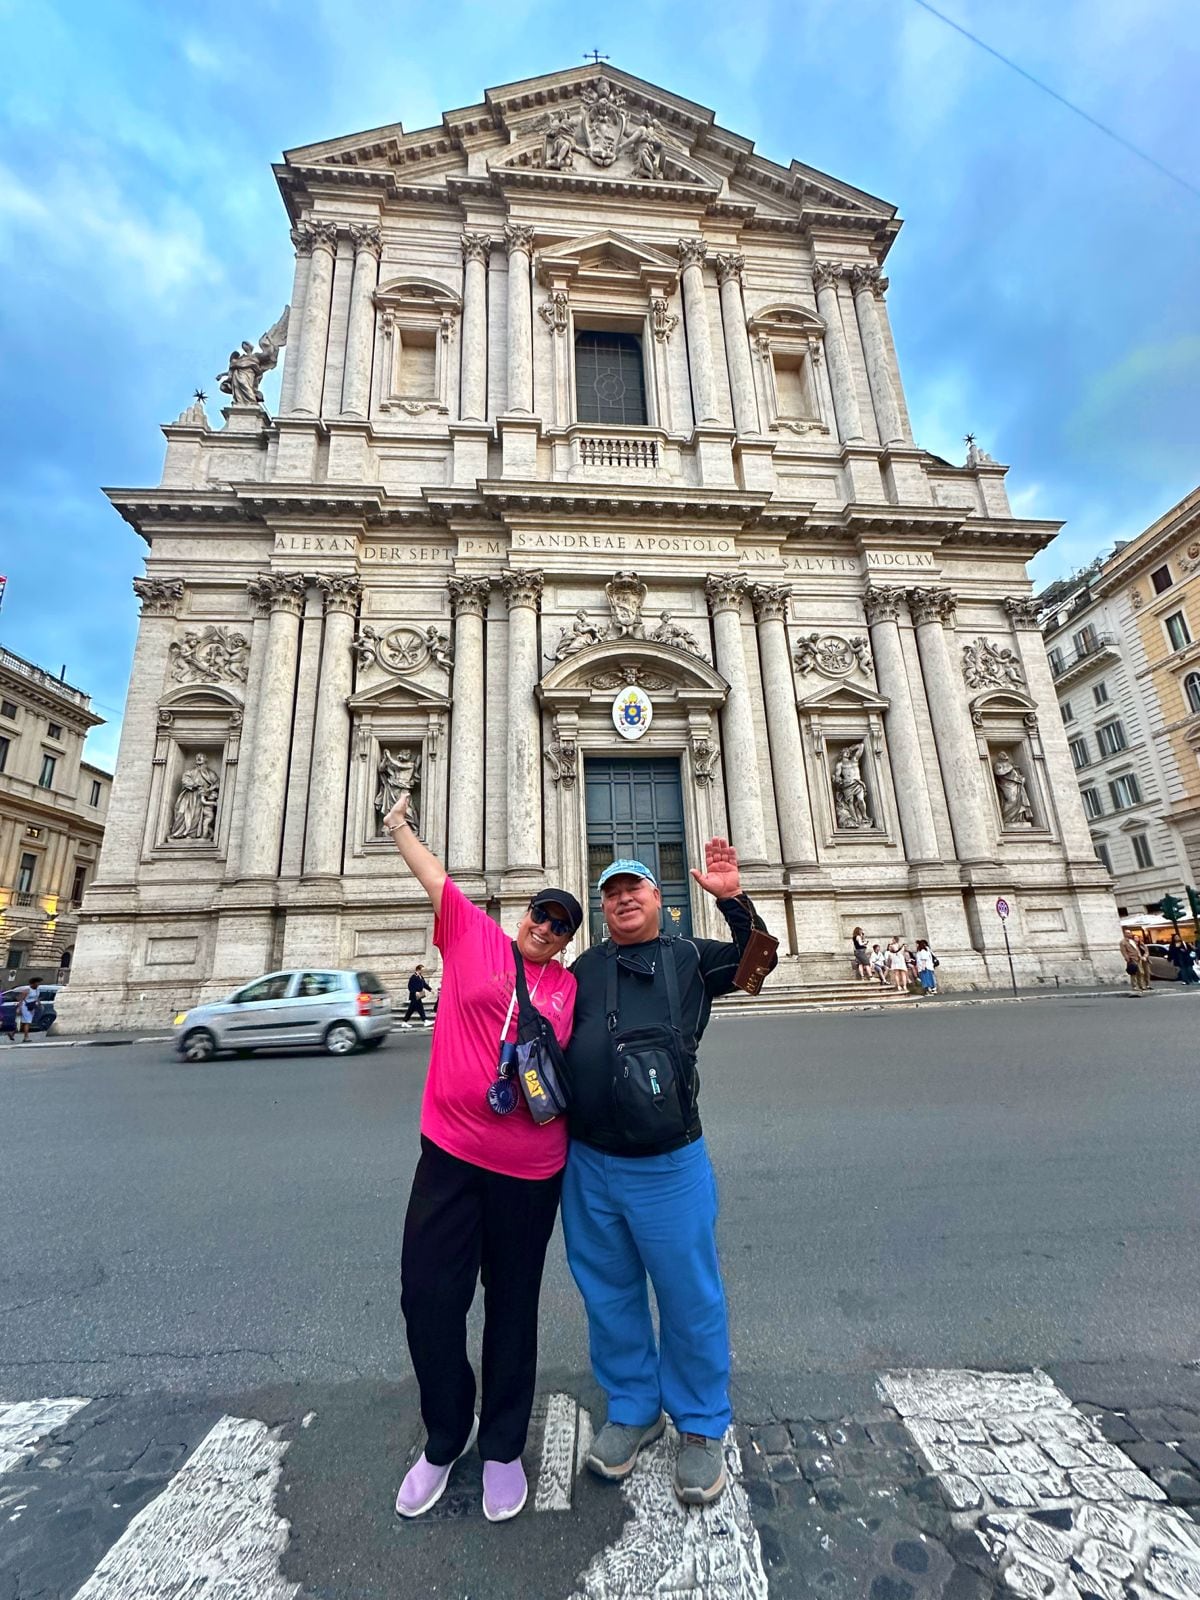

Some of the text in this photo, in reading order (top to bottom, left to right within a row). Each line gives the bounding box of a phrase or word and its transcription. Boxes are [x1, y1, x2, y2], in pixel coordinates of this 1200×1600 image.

[275, 537, 356, 550] ALEXAN
[364, 547, 401, 559] DER
[634, 538, 730, 552] APOSTOLO
[868, 553, 933, 566] MDCLXV
[524, 1069, 545, 1098] CAT
